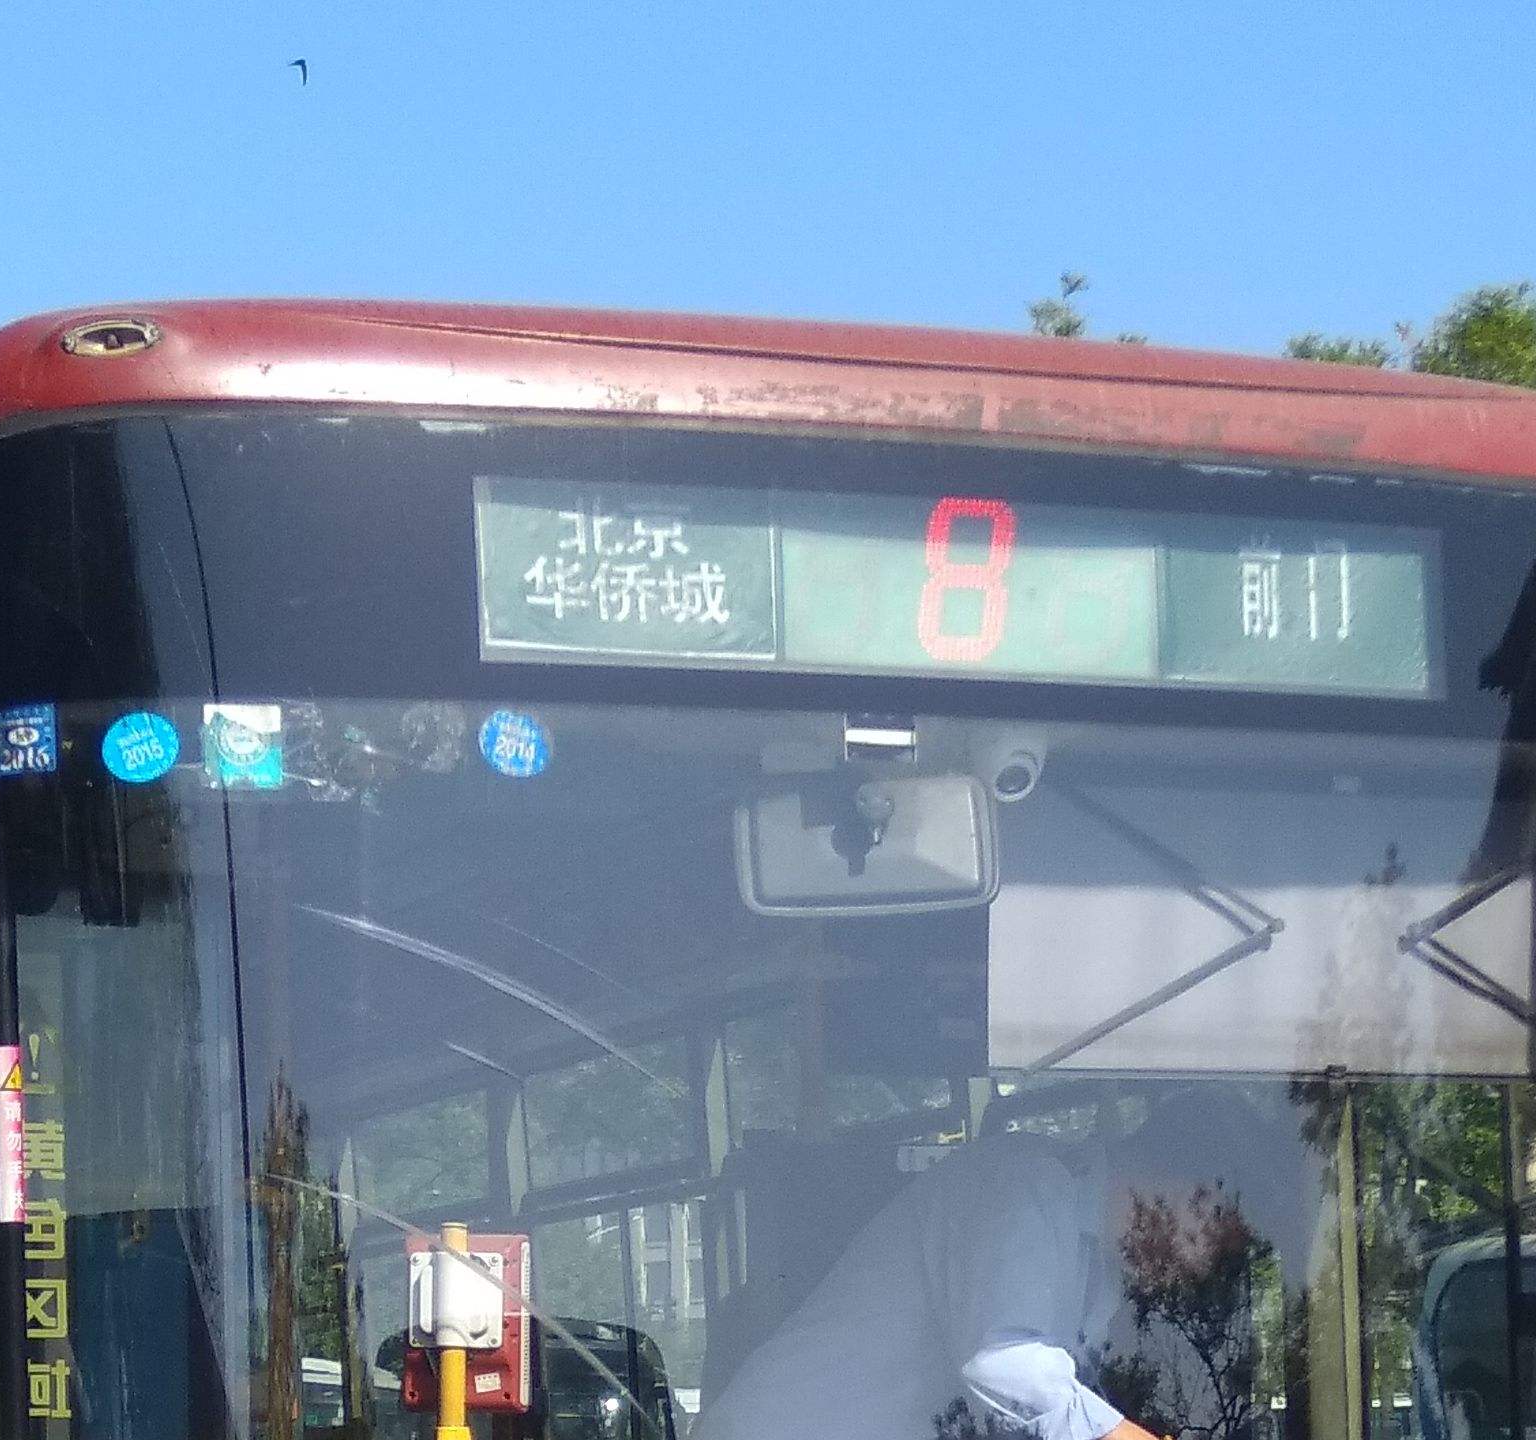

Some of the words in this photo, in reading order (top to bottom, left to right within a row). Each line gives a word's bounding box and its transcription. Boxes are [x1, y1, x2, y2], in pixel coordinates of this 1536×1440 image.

[558, 500, 690, 558] 北京
[524, 556, 730, 623] 华侨城
[918, 495, 1017, 661] 8
[1238, 538, 1349, 640] 前门
